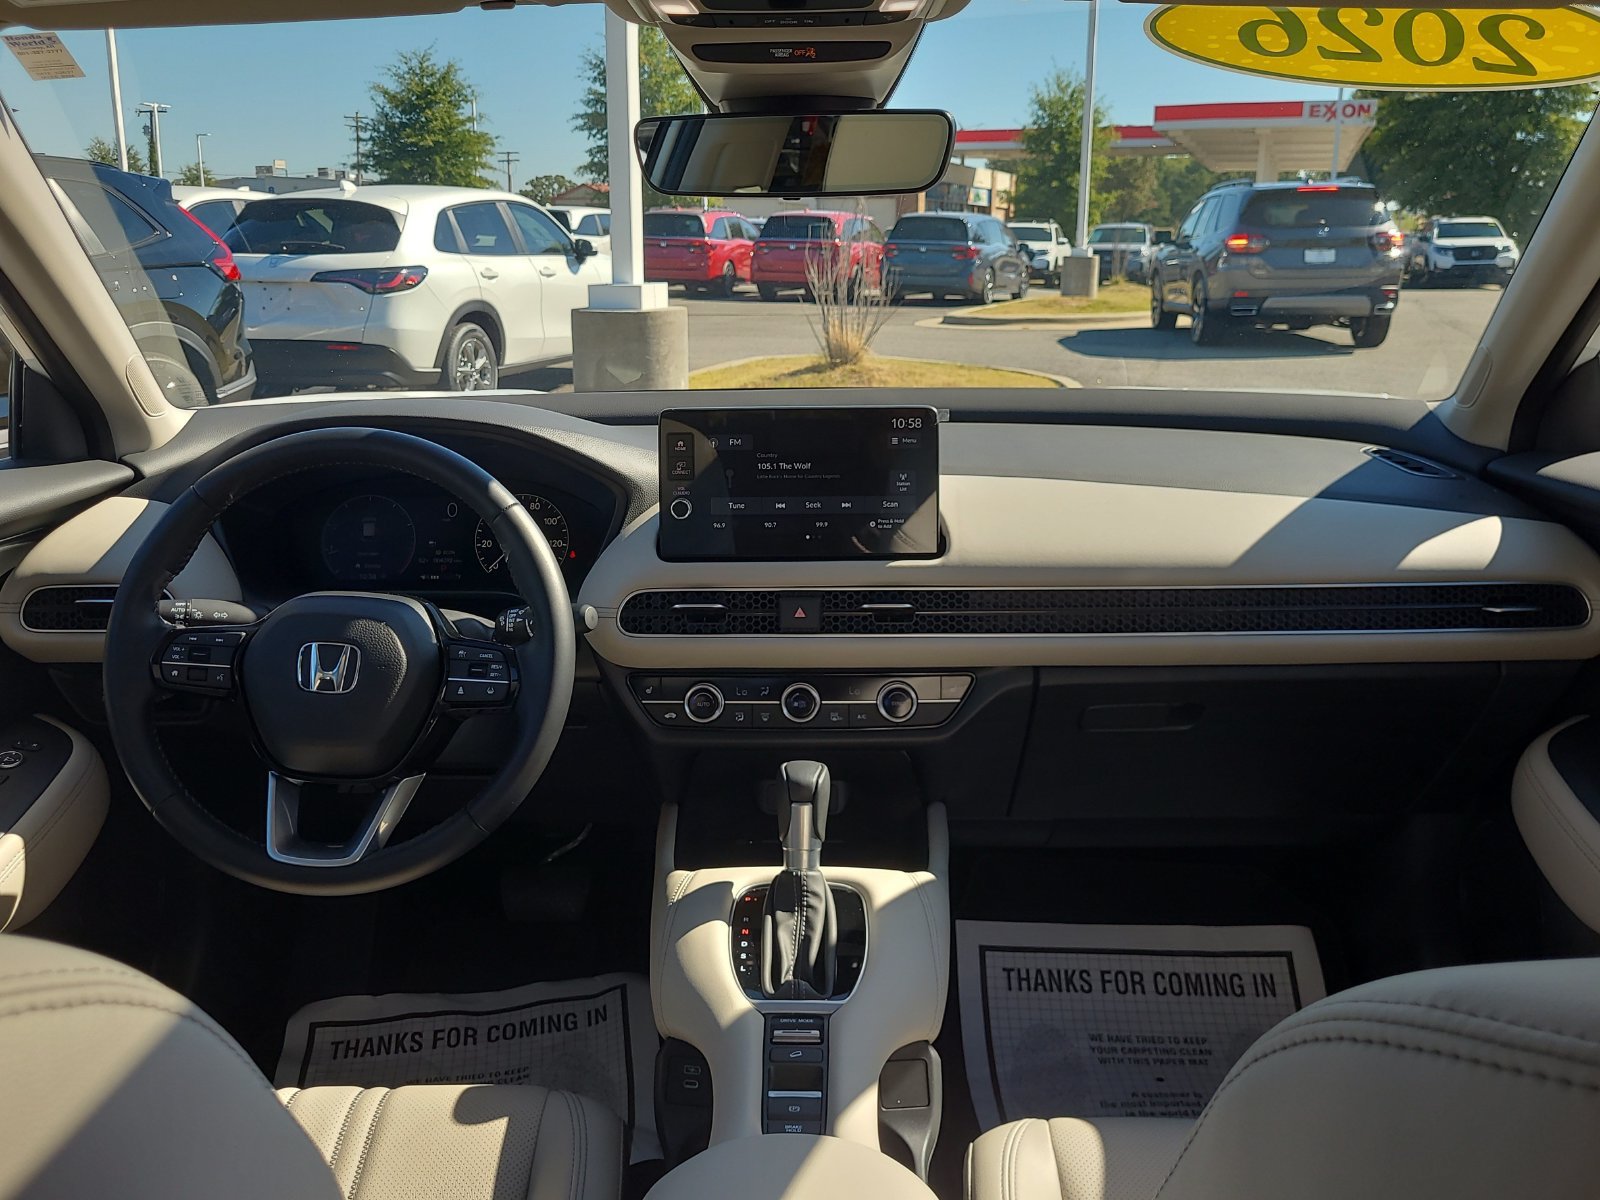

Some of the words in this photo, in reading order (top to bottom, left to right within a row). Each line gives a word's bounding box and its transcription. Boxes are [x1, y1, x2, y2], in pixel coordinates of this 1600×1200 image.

[1309, 102, 1372, 122] EXXON
[891, 418, 923, 429] 10:58
[729, 439, 742, 447] FM
[902, 437, 918, 445] Menu
[794, 462, 812, 470] Wolf
[447, 503, 458, 518] 0
[529, 503, 541, 511] 80
[728, 502, 746, 510] Tune
[805, 501, 822, 509] Seek
[543, 518, 558, 526] 100
[482, 540, 493, 548] 20
[550, 540, 563, 548] 120
[1002, 968, 1093, 994] THANKS
[1101, 970, 1147, 995] FOR
[1154, 971, 1246, 998] COMING
[1253, 974, 1278, 998] IN
[330, 1031, 424, 1062] THANKS
[432, 1026, 478, 1051] FOR
[487, 1012, 579, 1044] COMING
[587, 1004, 609, 1027] IN
[1089, 1033, 1104, 1043] WE
[1107, 1035, 1133, 1044] HAVE
[1135, 1035, 1165, 1045] TRIED
[1168, 1036, 1181, 1045] TO
[1182, 1036, 1208, 1046] KEEP
[1090, 1046, 1119, 1056] YOUR
[1121, 1047, 1178, 1056] CARPETING
[1179, 1047, 1213, 1057] CLEAN
[1098, 1057, 1126, 1066] WITH
[1128, 1058, 1151, 1066] THIS
[1153, 1058, 1185, 1066] PAPER
[425, 1076, 452, 1084] HAVE
[456, 1074, 485, 1082] TRIED
[504, 1066, 530, 1076] KEEP
[497, 1074, 531, 1085] CLEAN
